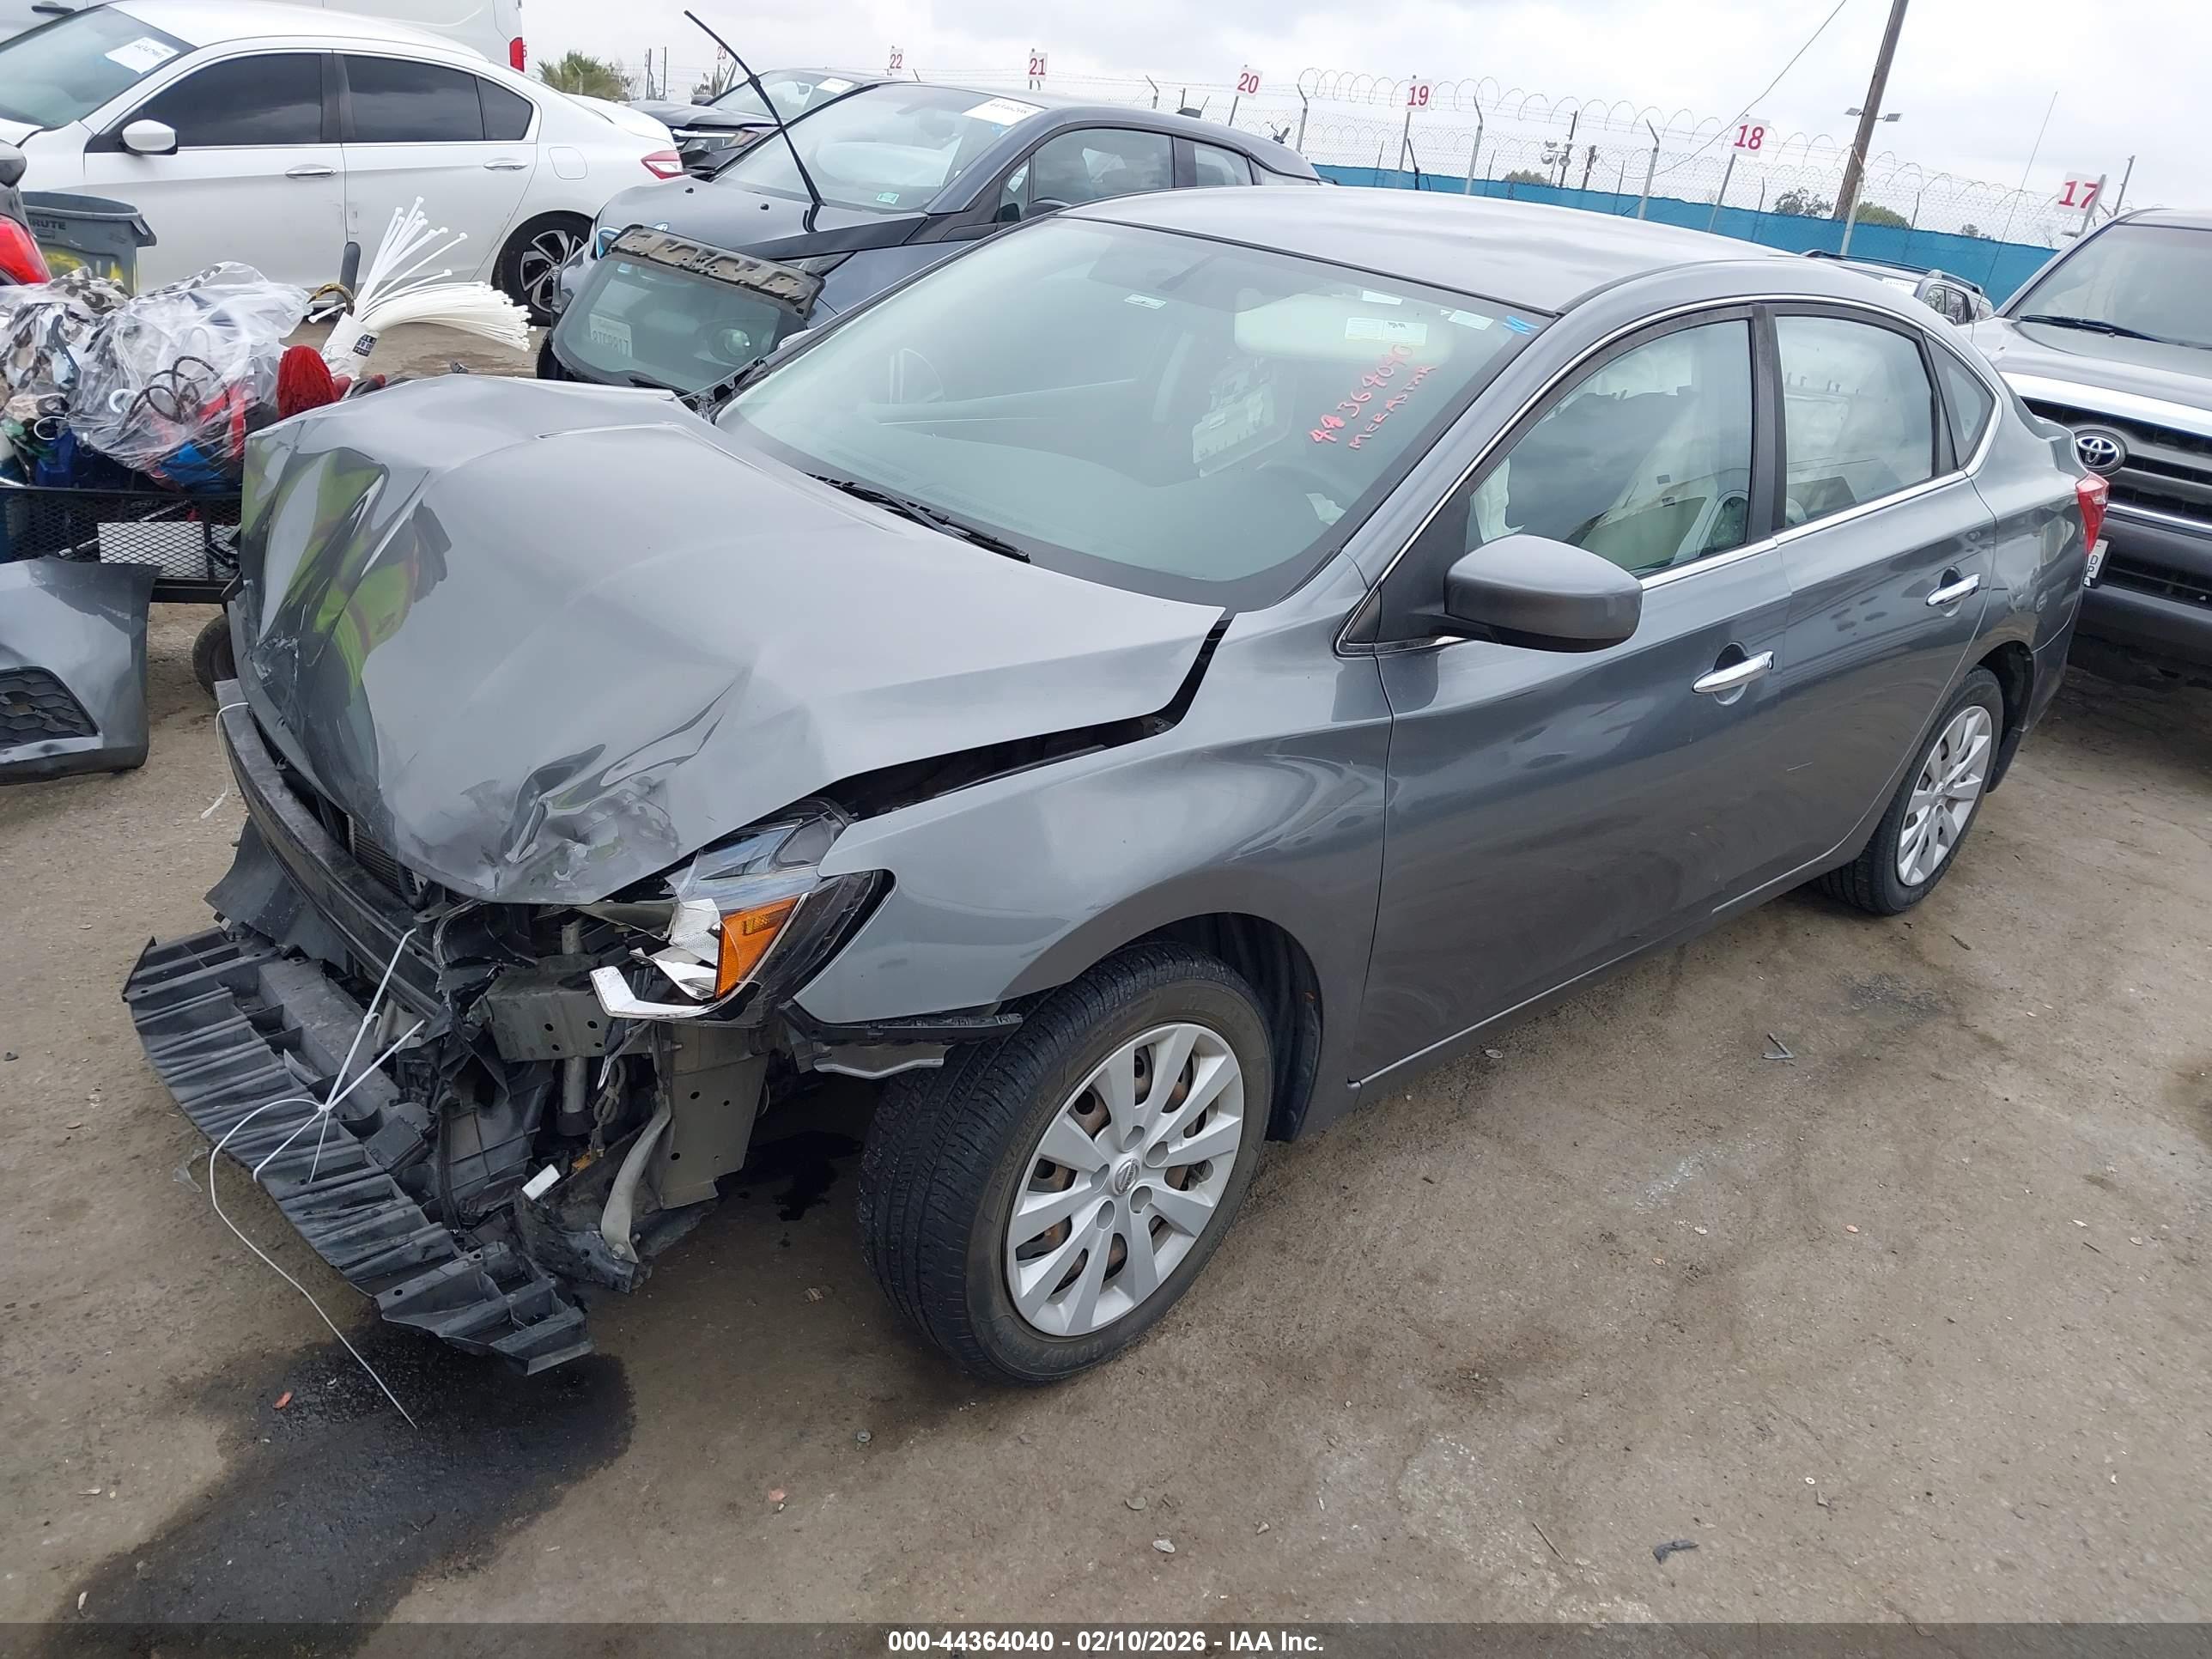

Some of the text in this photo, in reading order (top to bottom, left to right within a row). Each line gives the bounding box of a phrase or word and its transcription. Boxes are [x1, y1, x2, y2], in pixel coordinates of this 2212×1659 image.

[890, 53, 902, 69] 22
[1029, 58, 1046, 76] 21
[1237, 72, 1259, 94] 20
[1407, 85, 1429, 106] 19
[1734, 125, 1765, 150] 18
[2057, 180, 2101, 209] 17
